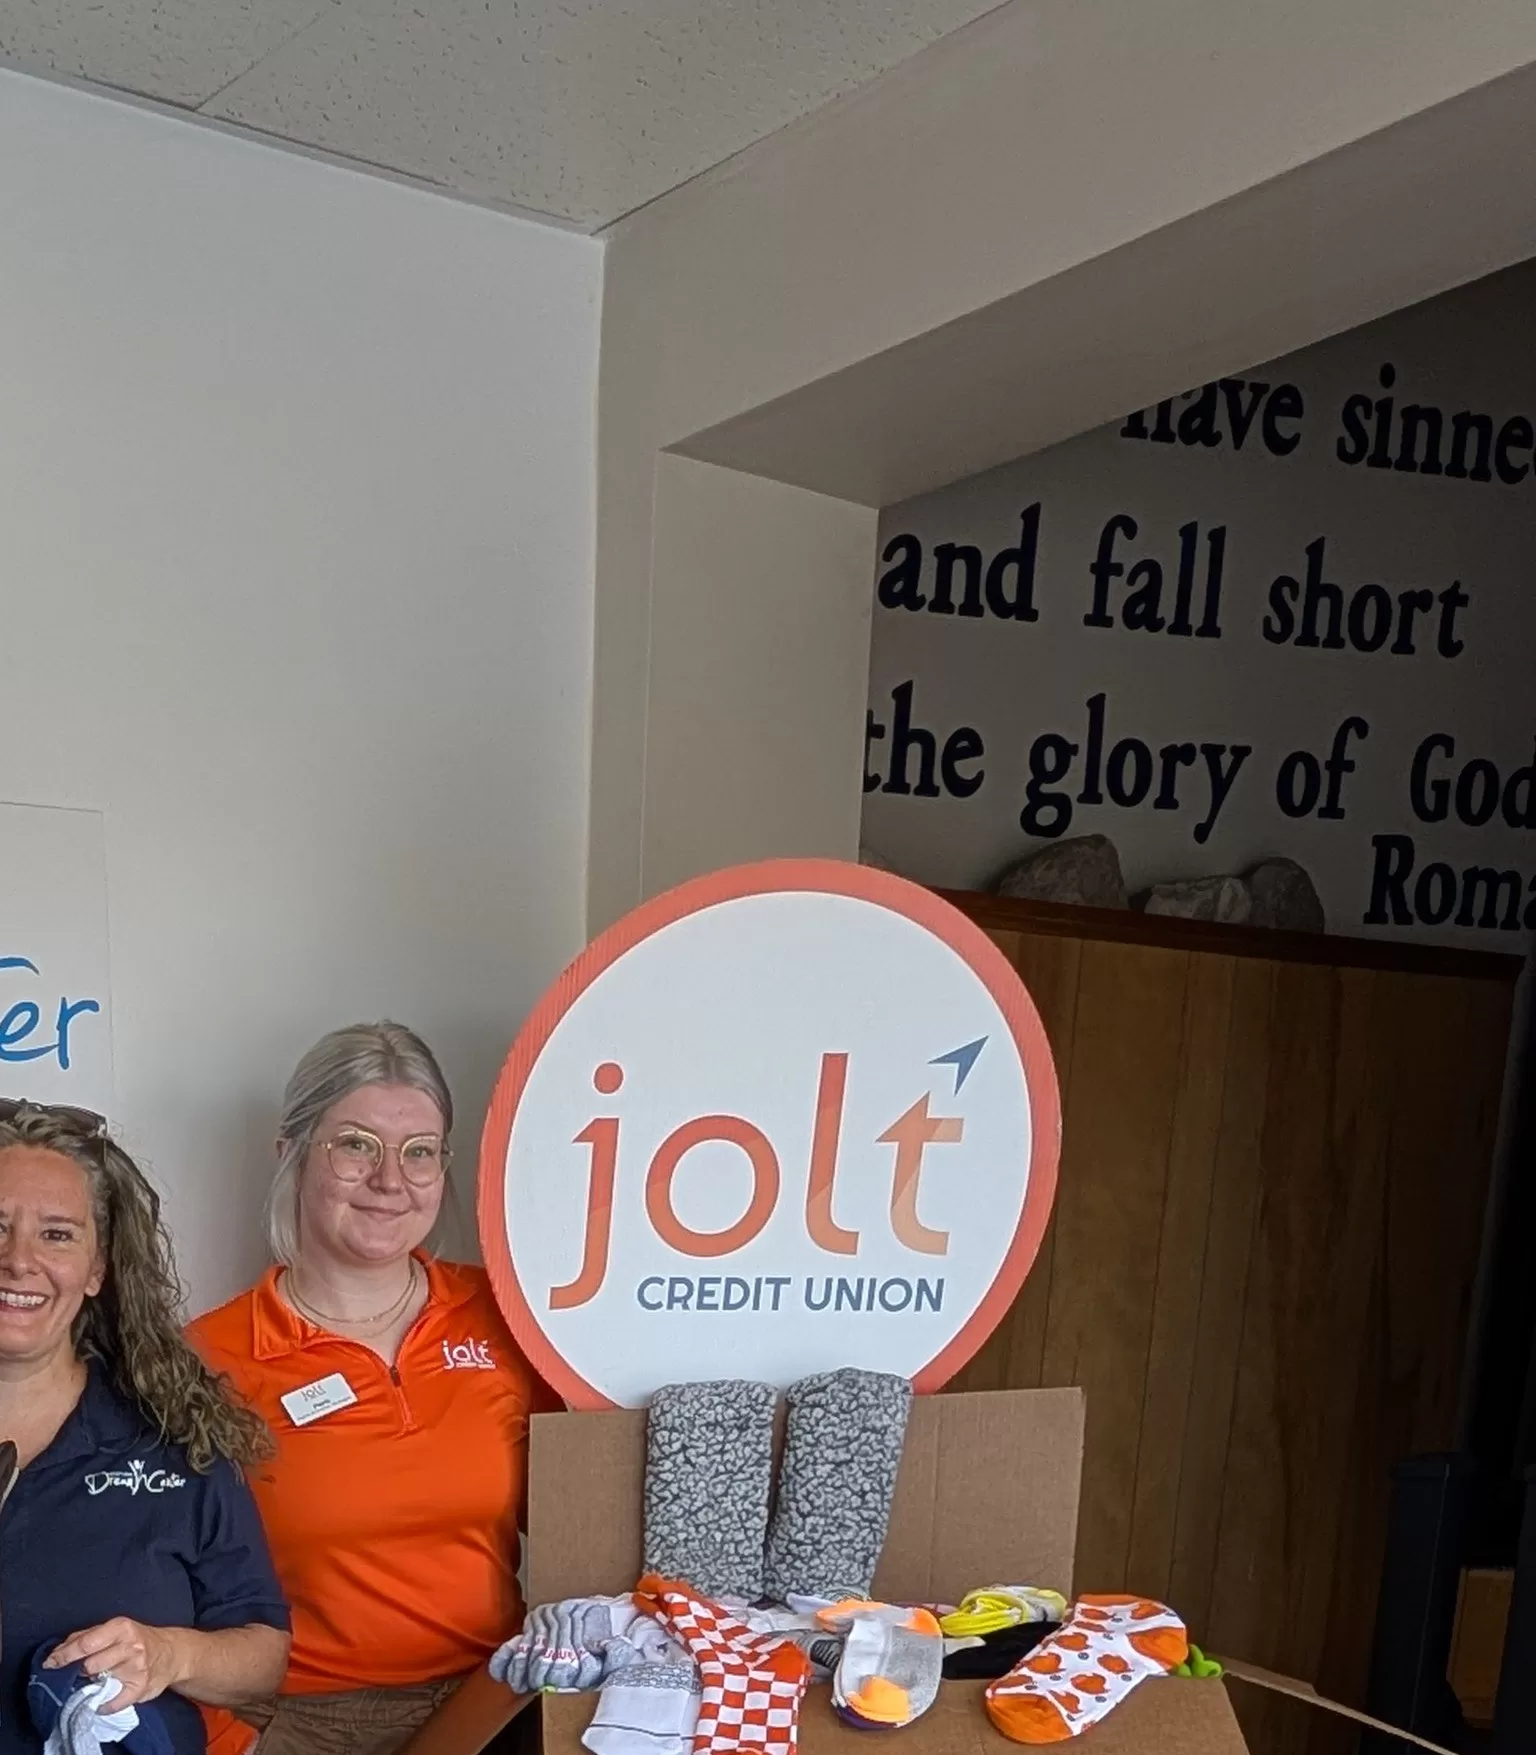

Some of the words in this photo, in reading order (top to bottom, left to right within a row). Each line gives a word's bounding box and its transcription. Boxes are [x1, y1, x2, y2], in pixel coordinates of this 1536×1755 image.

[1336, 362, 1536, 484] sinne
[877, 503, 1042, 622] and
[1084, 514, 1227, 639] fall
[1263, 537, 1469, 658] short
[864, 680, 985, 798] the
[1020, 693, 1252, 844] glory
[1276, 716, 1369, 820] of
[549, 1053, 965, 1311] jolt
[443, 1336, 493, 1369] jolt
[637, 1276, 792, 1312] CREDIT
[804, 1276, 946, 1313] UNION
